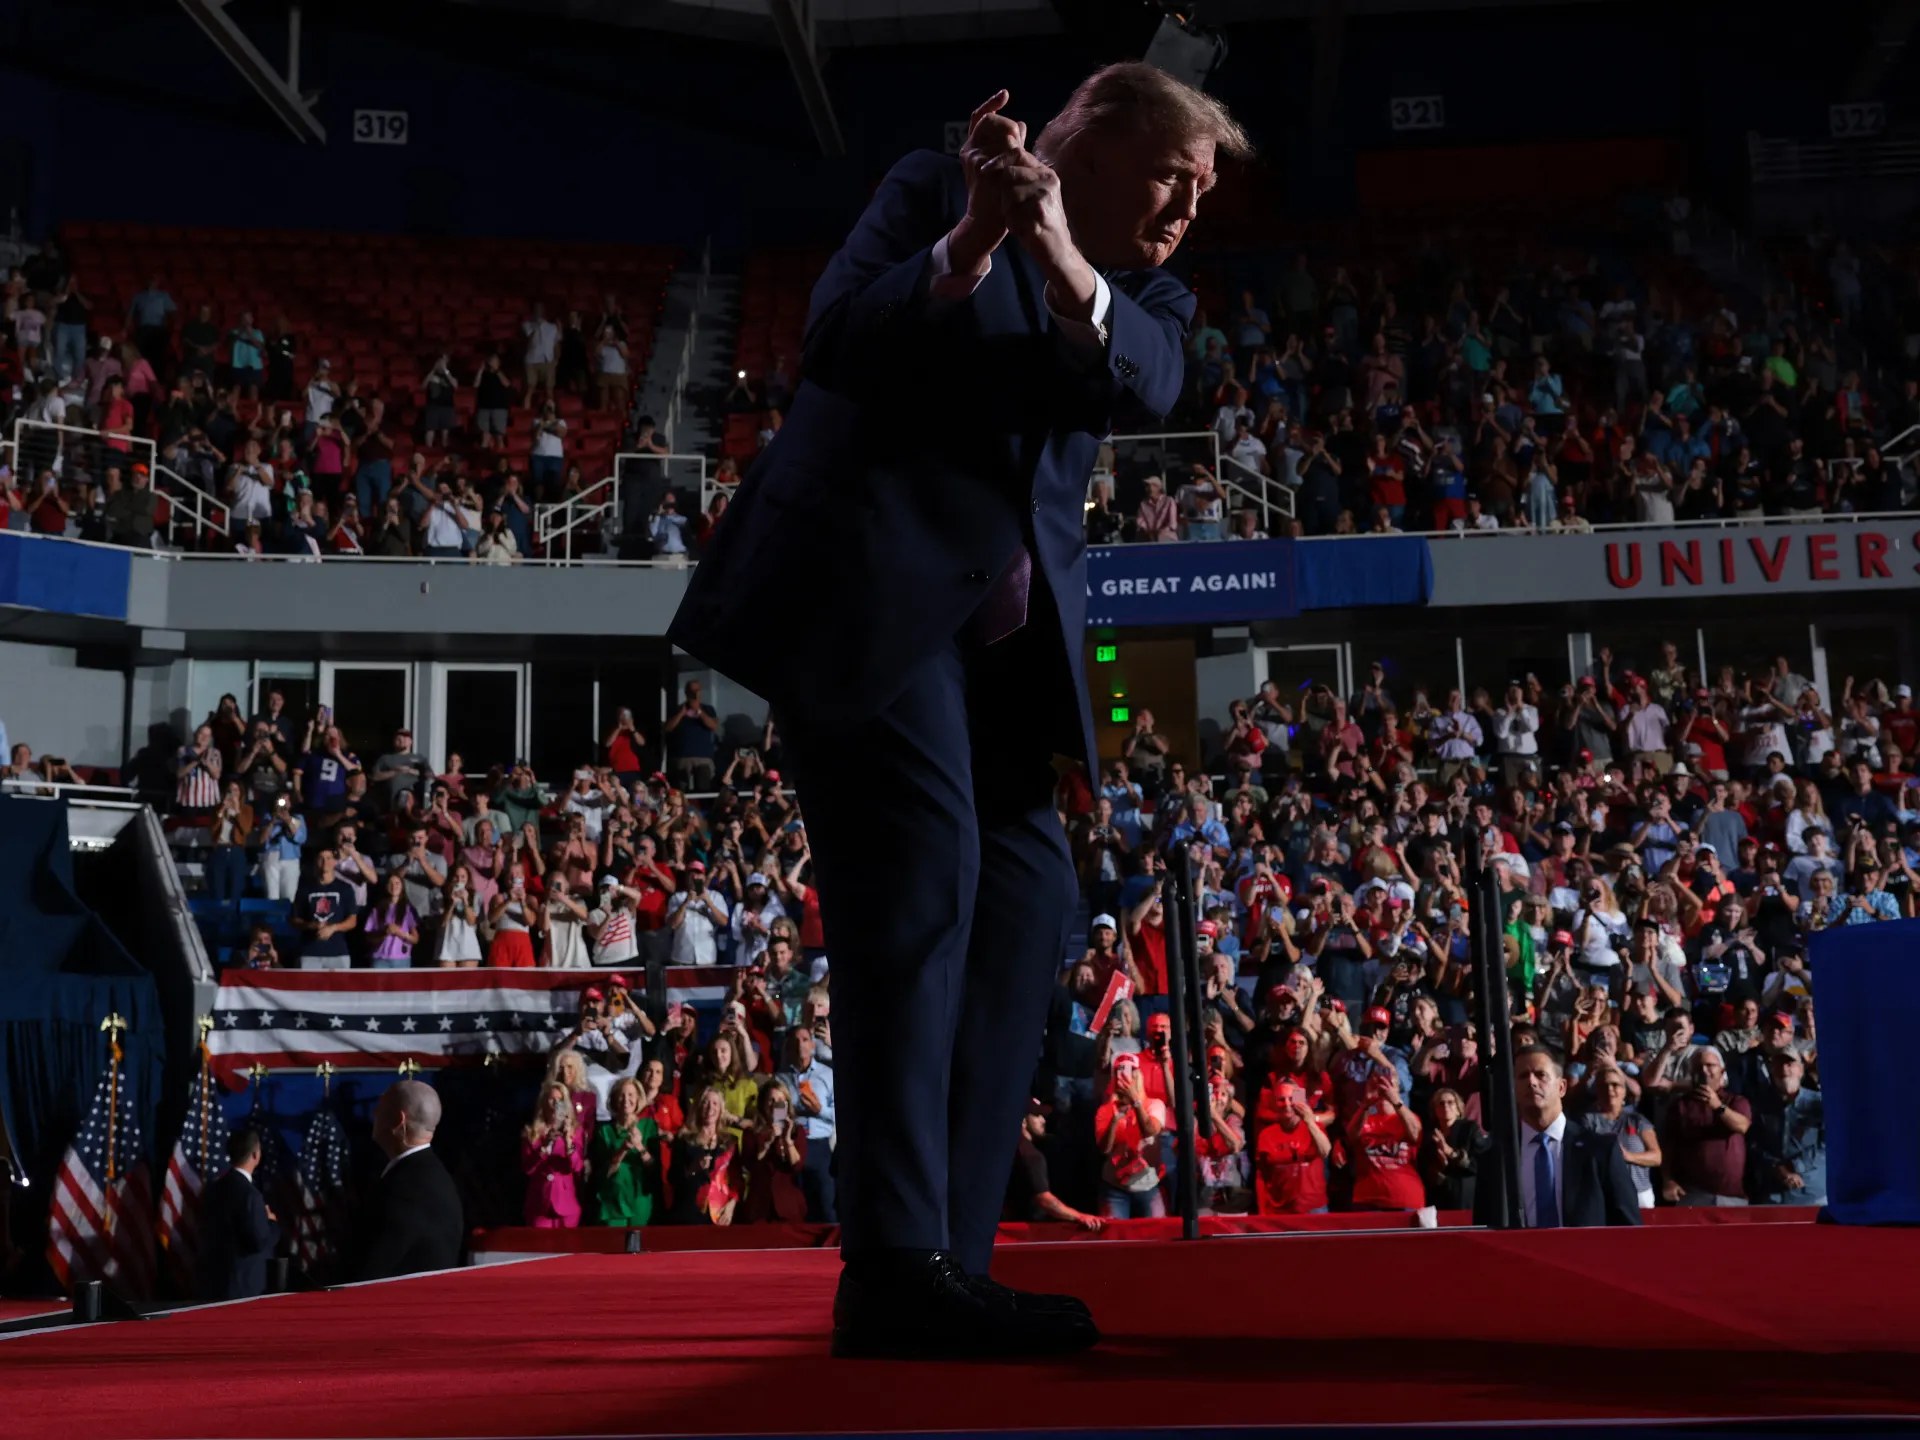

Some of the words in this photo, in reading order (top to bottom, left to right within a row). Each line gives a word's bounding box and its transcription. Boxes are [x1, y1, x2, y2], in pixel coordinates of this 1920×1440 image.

[1393, 101, 1442, 125] 321
[357, 114, 405, 139] 319
[1101, 577, 1181, 596] GREAT
[1190, 572, 1276, 592] AGAIN!
[320, 757, 339, 782] 9
